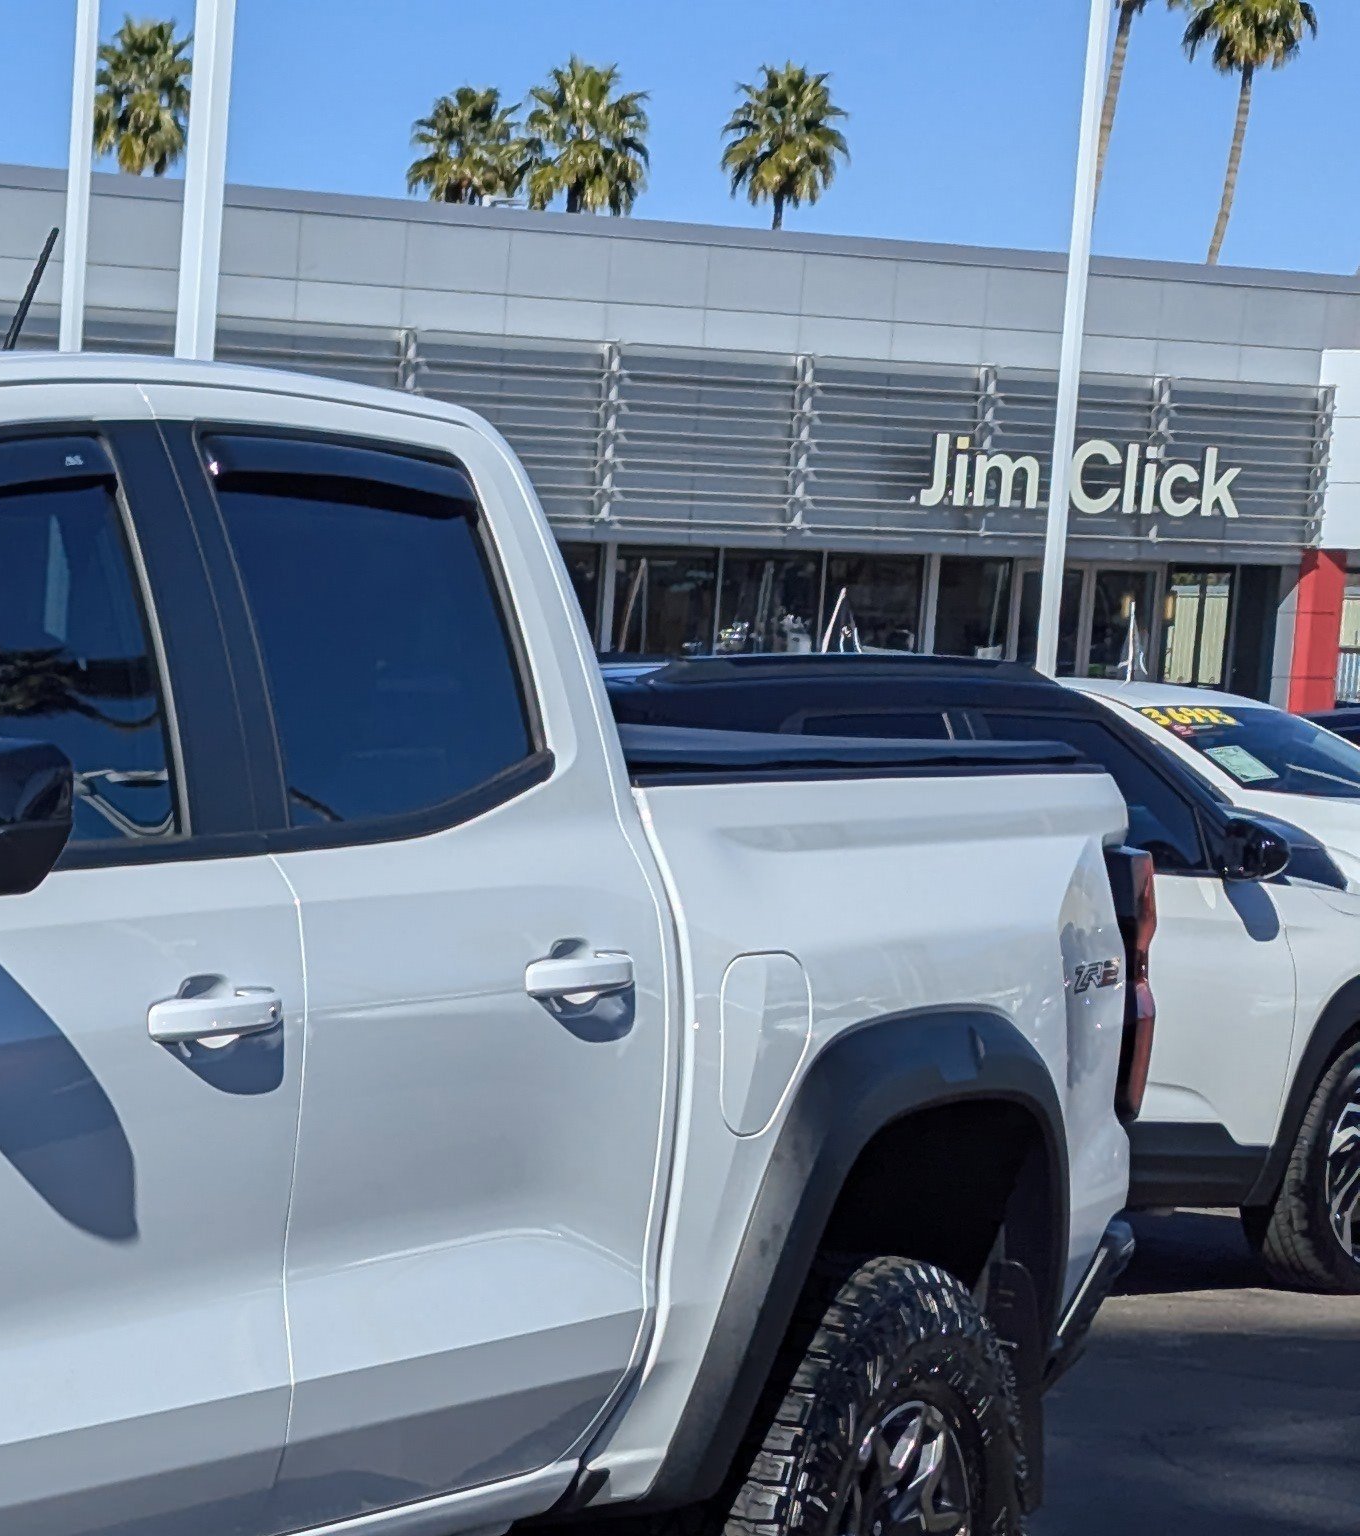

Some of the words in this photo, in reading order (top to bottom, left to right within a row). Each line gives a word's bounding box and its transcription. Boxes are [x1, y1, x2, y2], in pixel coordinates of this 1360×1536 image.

[920, 433, 1040, 509] Jim
[1069, 440, 1242, 518] Click
[1074, 960, 1120, 994] ZR2
